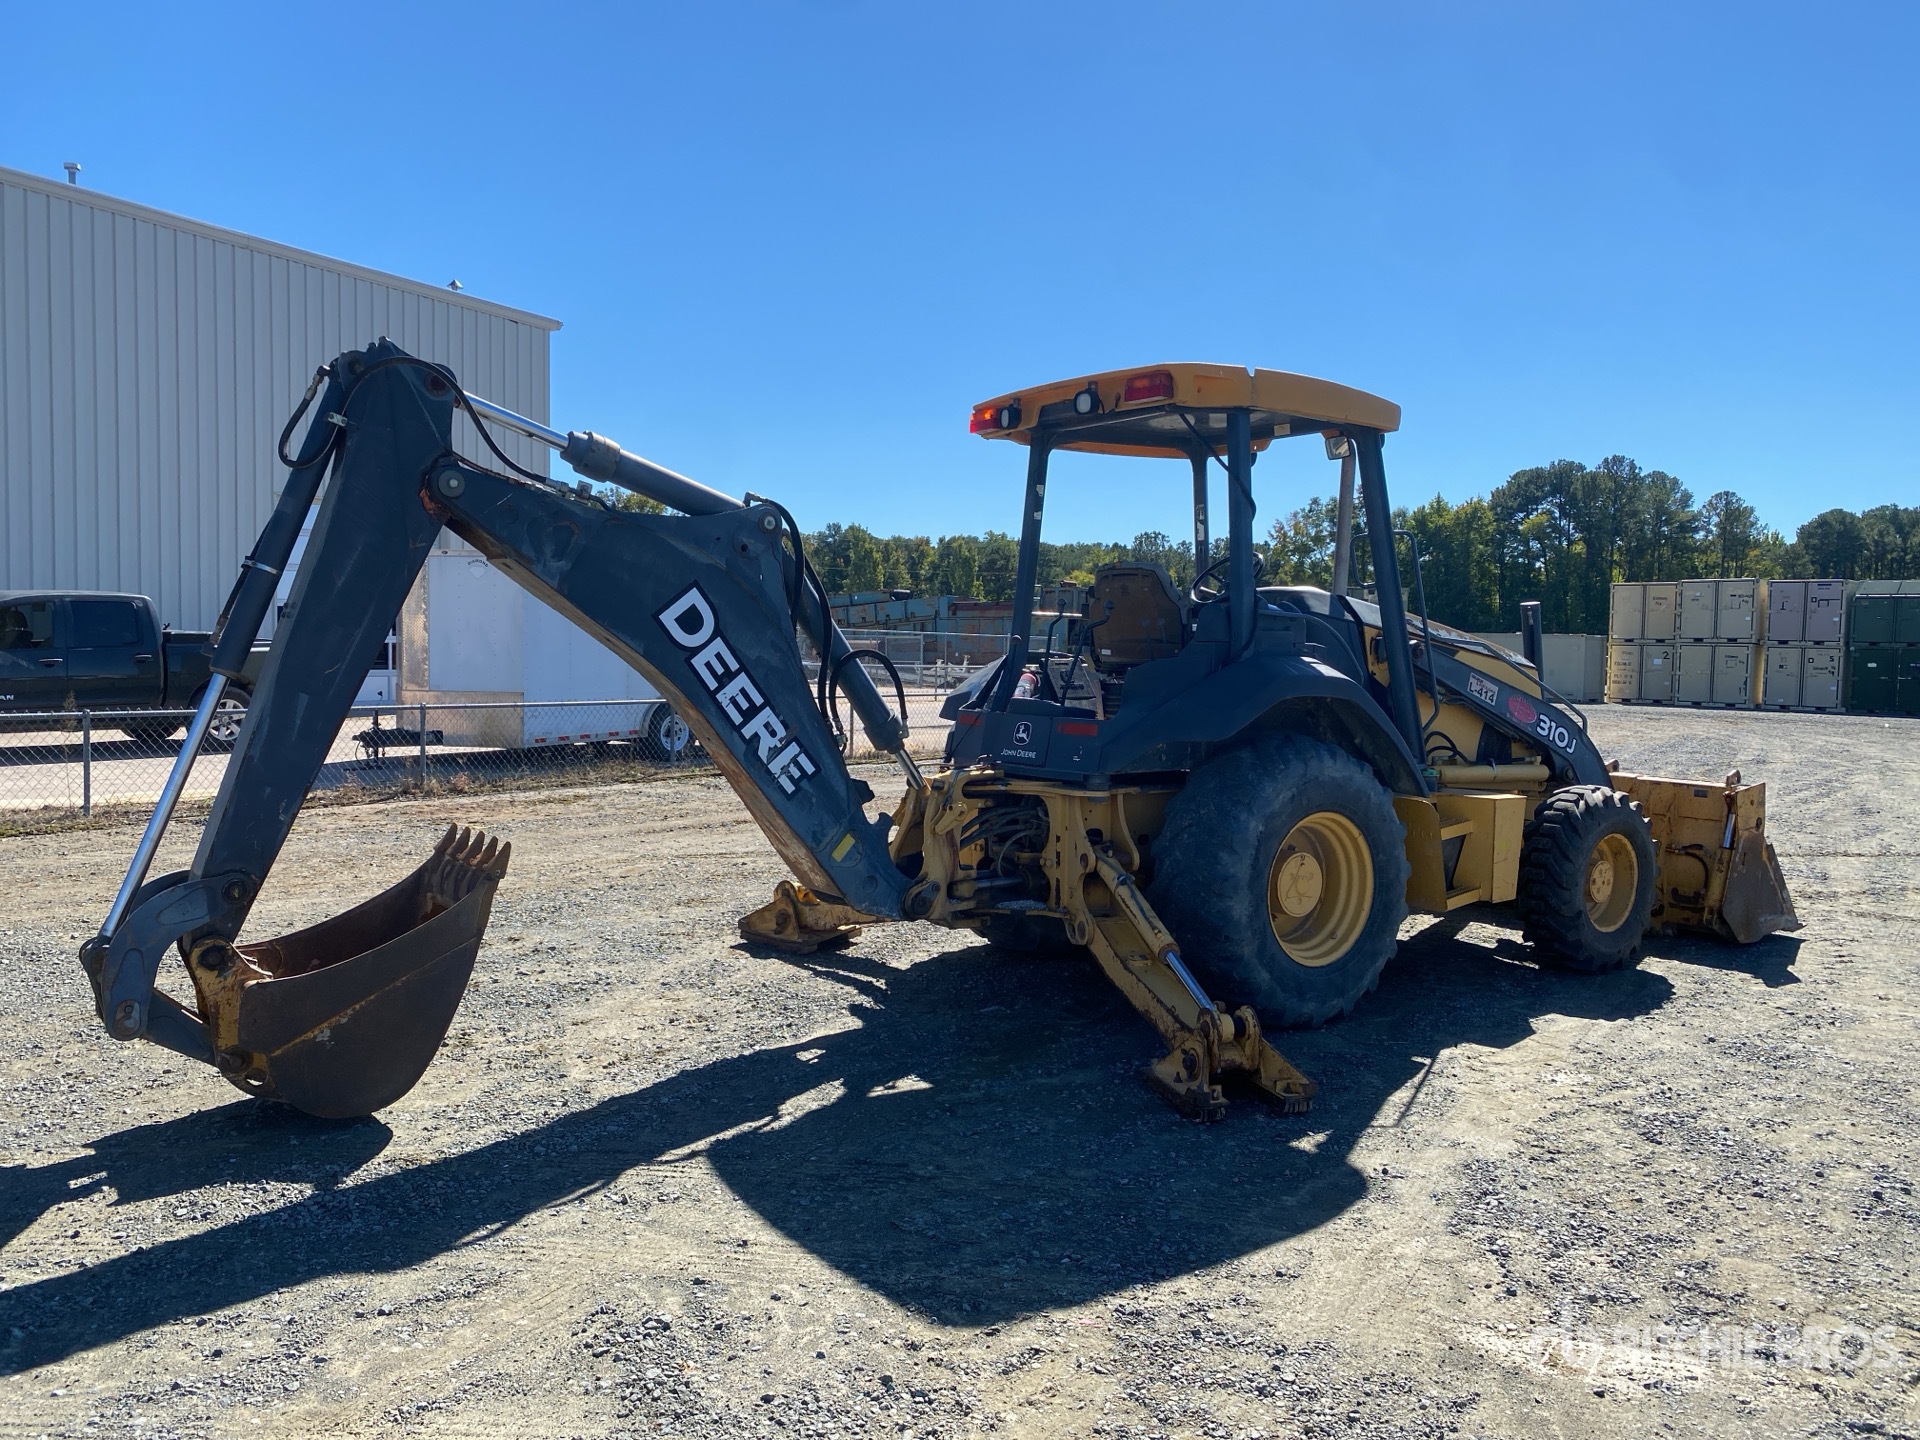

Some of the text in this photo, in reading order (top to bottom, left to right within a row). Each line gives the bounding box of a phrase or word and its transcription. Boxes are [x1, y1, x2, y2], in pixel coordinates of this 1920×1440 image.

[1662, 650, 1671, 660] 2
[657, 586, 816, 795] DEERE
[1469, 682, 1495, 704] L-414
[1536, 714, 1577, 754] 310J
[1000, 748, 1037, 759] JOHN DEERE
